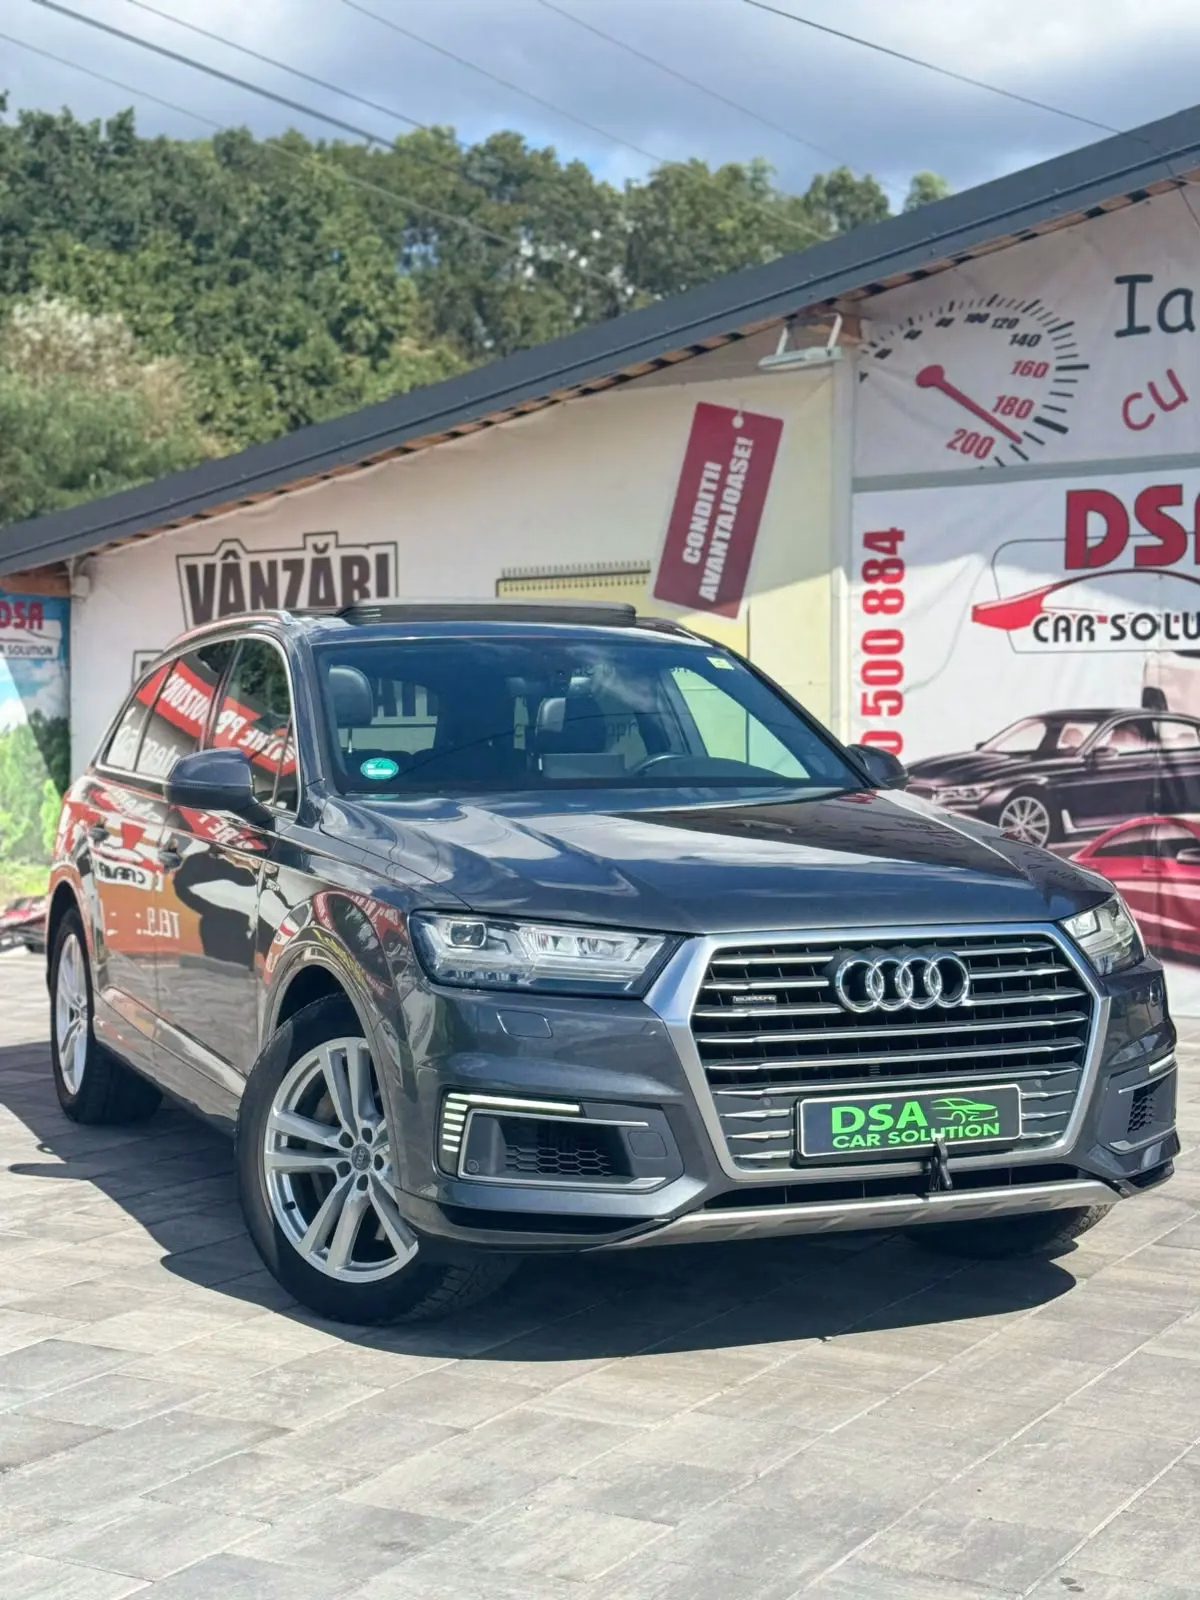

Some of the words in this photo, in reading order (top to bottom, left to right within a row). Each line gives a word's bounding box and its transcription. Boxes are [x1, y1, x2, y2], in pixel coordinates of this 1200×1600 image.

[1114, 273, 1196, 338] Ia
[1009, 333, 1042, 347] 140
[1011, 359, 1050, 379] 160
[992, 395, 1035, 420] 180
[1121, 368, 1189, 432] cu
[946, 428, 996, 460] 200
[682, 461, 722, 565] CONDITII
[698, 436, 754, 602] AVANTAJOASE!
[1065, 484, 1200, 570] DS
[861, 527, 905, 615] 884
[1033, 614, 1095, 643] CAR
[861, 629, 905, 716] 500
[831, 1101, 928, 1134] DSA
[832, 1134, 881, 1149] CAR
